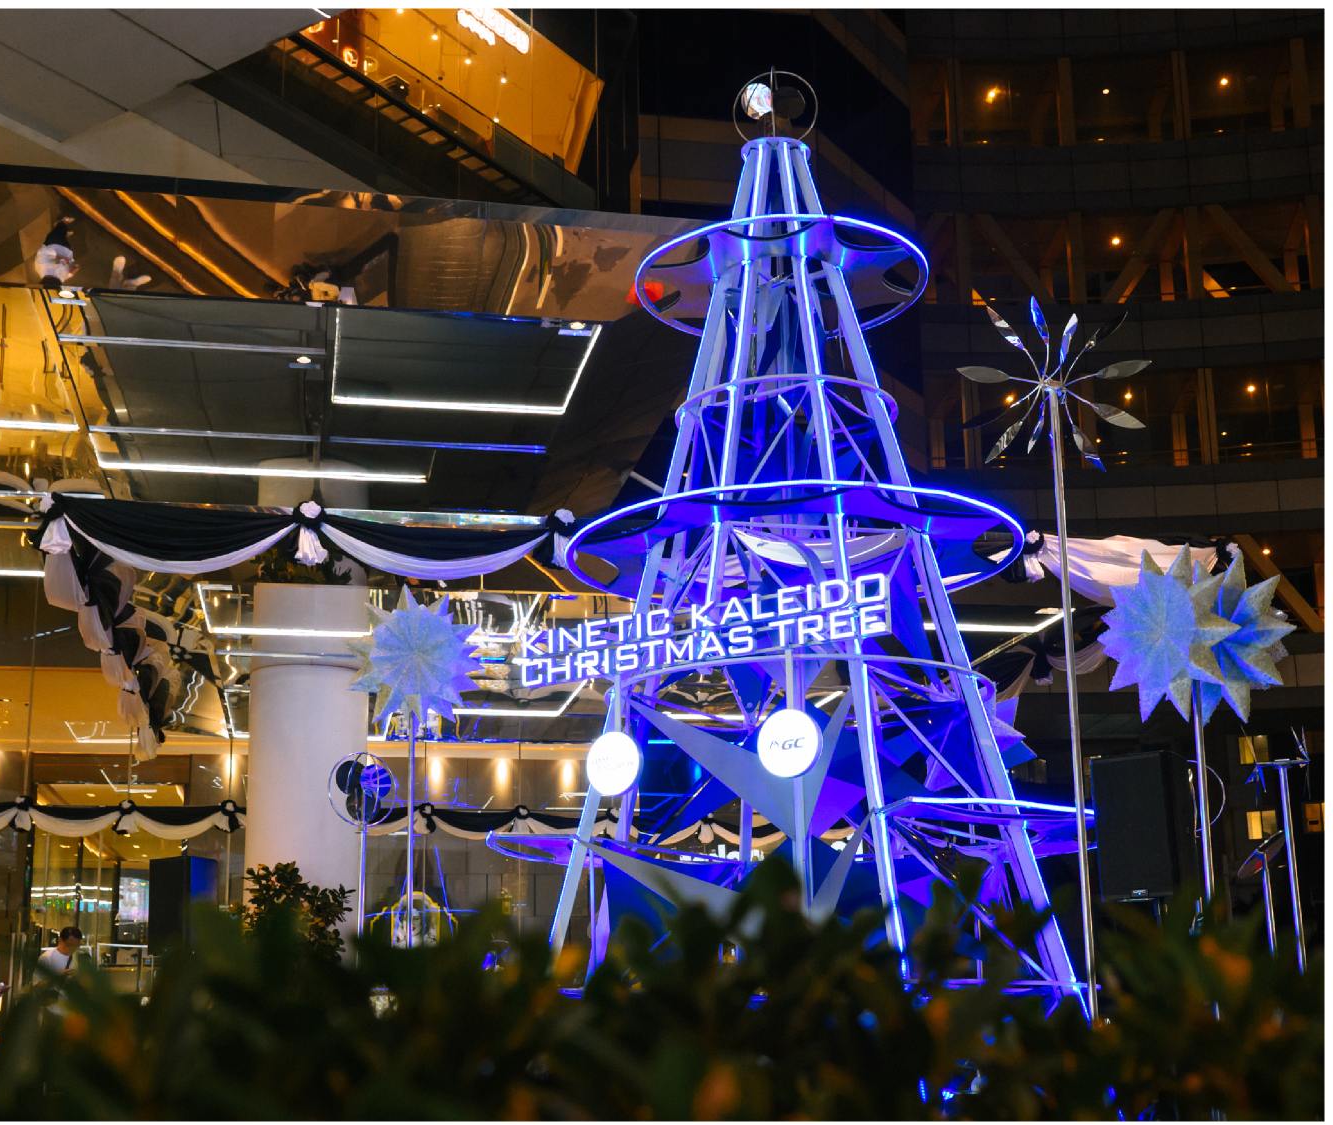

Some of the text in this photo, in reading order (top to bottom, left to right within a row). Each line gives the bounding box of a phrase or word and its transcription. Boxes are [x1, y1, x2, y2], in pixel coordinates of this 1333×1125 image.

[520, 604, 887, 688] CHRISTMAS TREE
[521, 572, 887, 658] KINETIC KALEIDO
